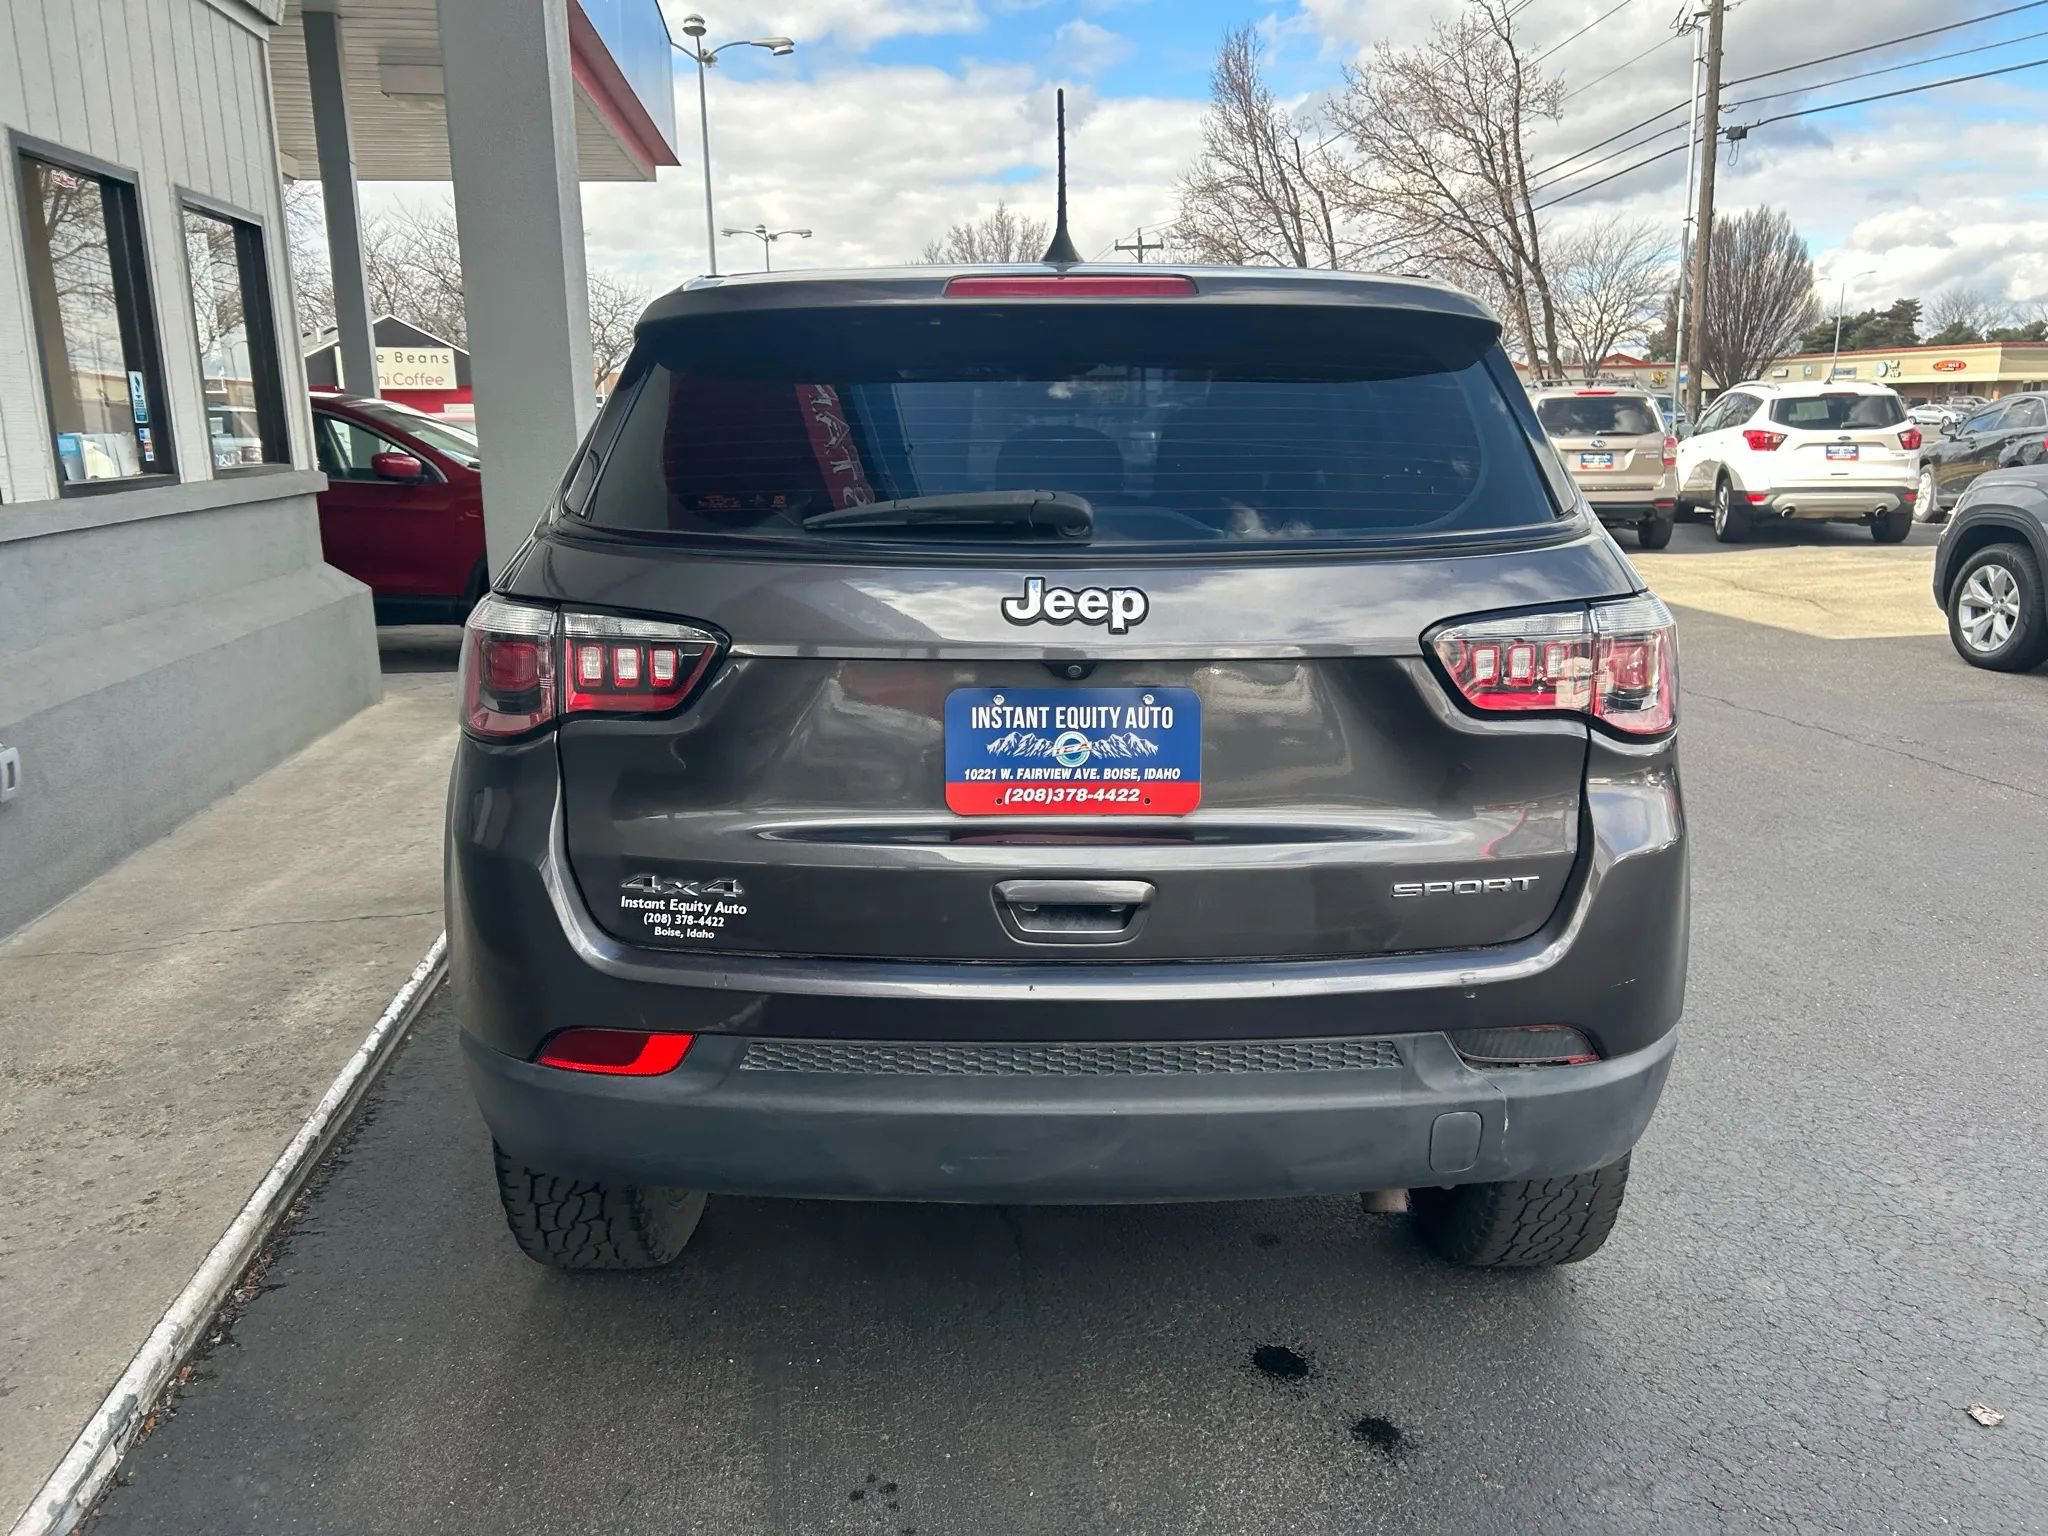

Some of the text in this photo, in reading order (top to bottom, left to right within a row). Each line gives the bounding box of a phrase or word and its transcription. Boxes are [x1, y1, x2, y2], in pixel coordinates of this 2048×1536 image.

[394, 351, 449, 364] Beans
[393, 372, 445, 386] Coffee
[1002, 577, 1149, 634] Jeep
[971, 706, 1174, 729] INSTANT EQUITY AUTO
[964, 767, 1181, 782] 10221 W. FAIRVIEW AVE. BOISE, IDAHO
[1004, 787, 1141, 805] (208)378-4422
[1391, 875, 1540, 898] SPORT
[620, 895, 748, 916] Instant Equity Auto
[643, 912, 725, 928] (208) 378-4422
[654, 926, 715, 939] Boise, Idaho
